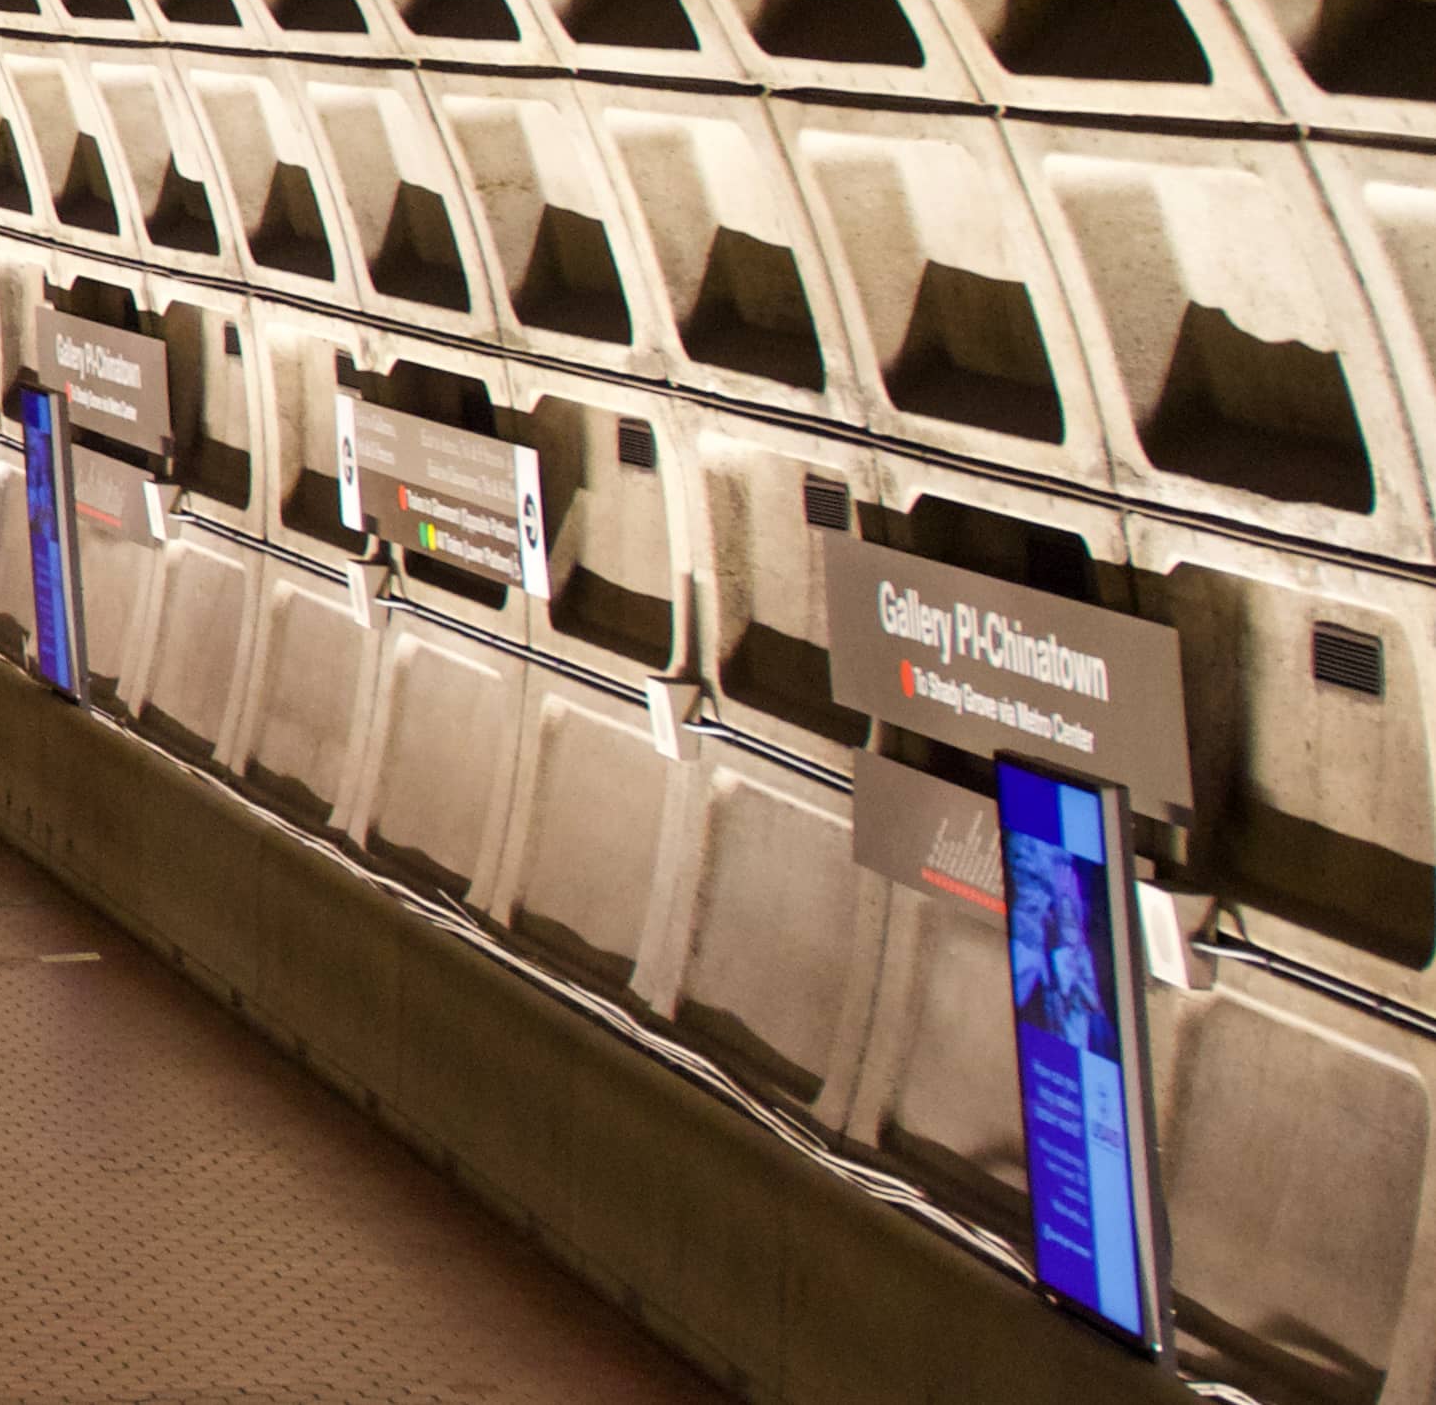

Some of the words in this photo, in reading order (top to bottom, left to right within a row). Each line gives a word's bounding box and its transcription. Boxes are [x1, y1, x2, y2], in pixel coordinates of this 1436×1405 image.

[878, 580, 952, 664] Gallery
[954, 601, 1109, 703] Pl-Chinatown
[912, 666, 927, 696] To
